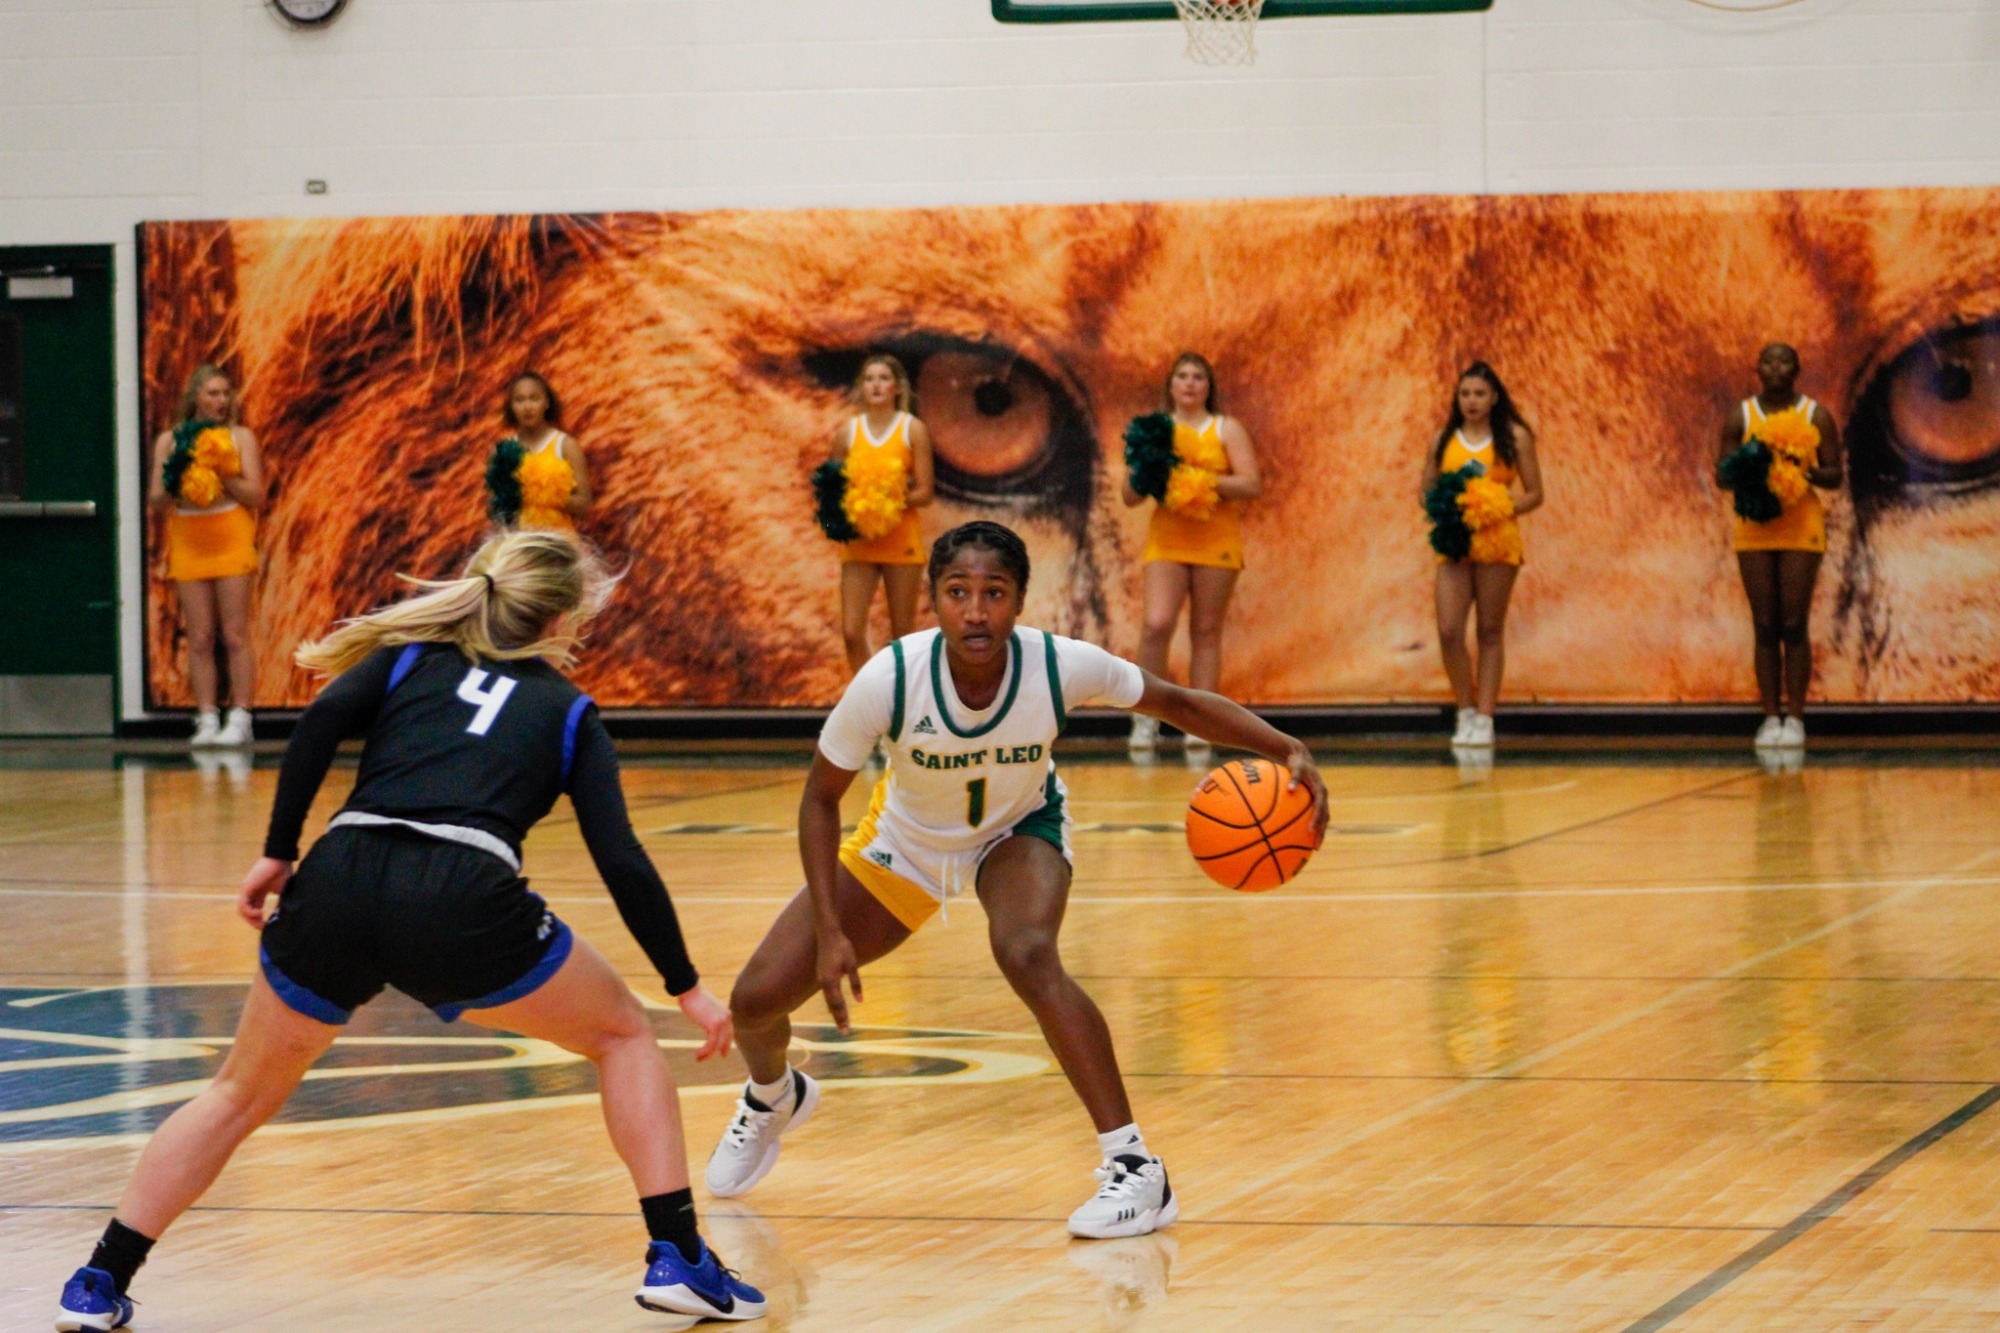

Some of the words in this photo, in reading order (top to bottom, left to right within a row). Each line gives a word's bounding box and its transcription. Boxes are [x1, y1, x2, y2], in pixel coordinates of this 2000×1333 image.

[456, 666, 518, 736] 4
[911, 748, 988, 769] SAINT
[996, 744, 1043, 764] LEO
[967, 777, 986, 829] 1
